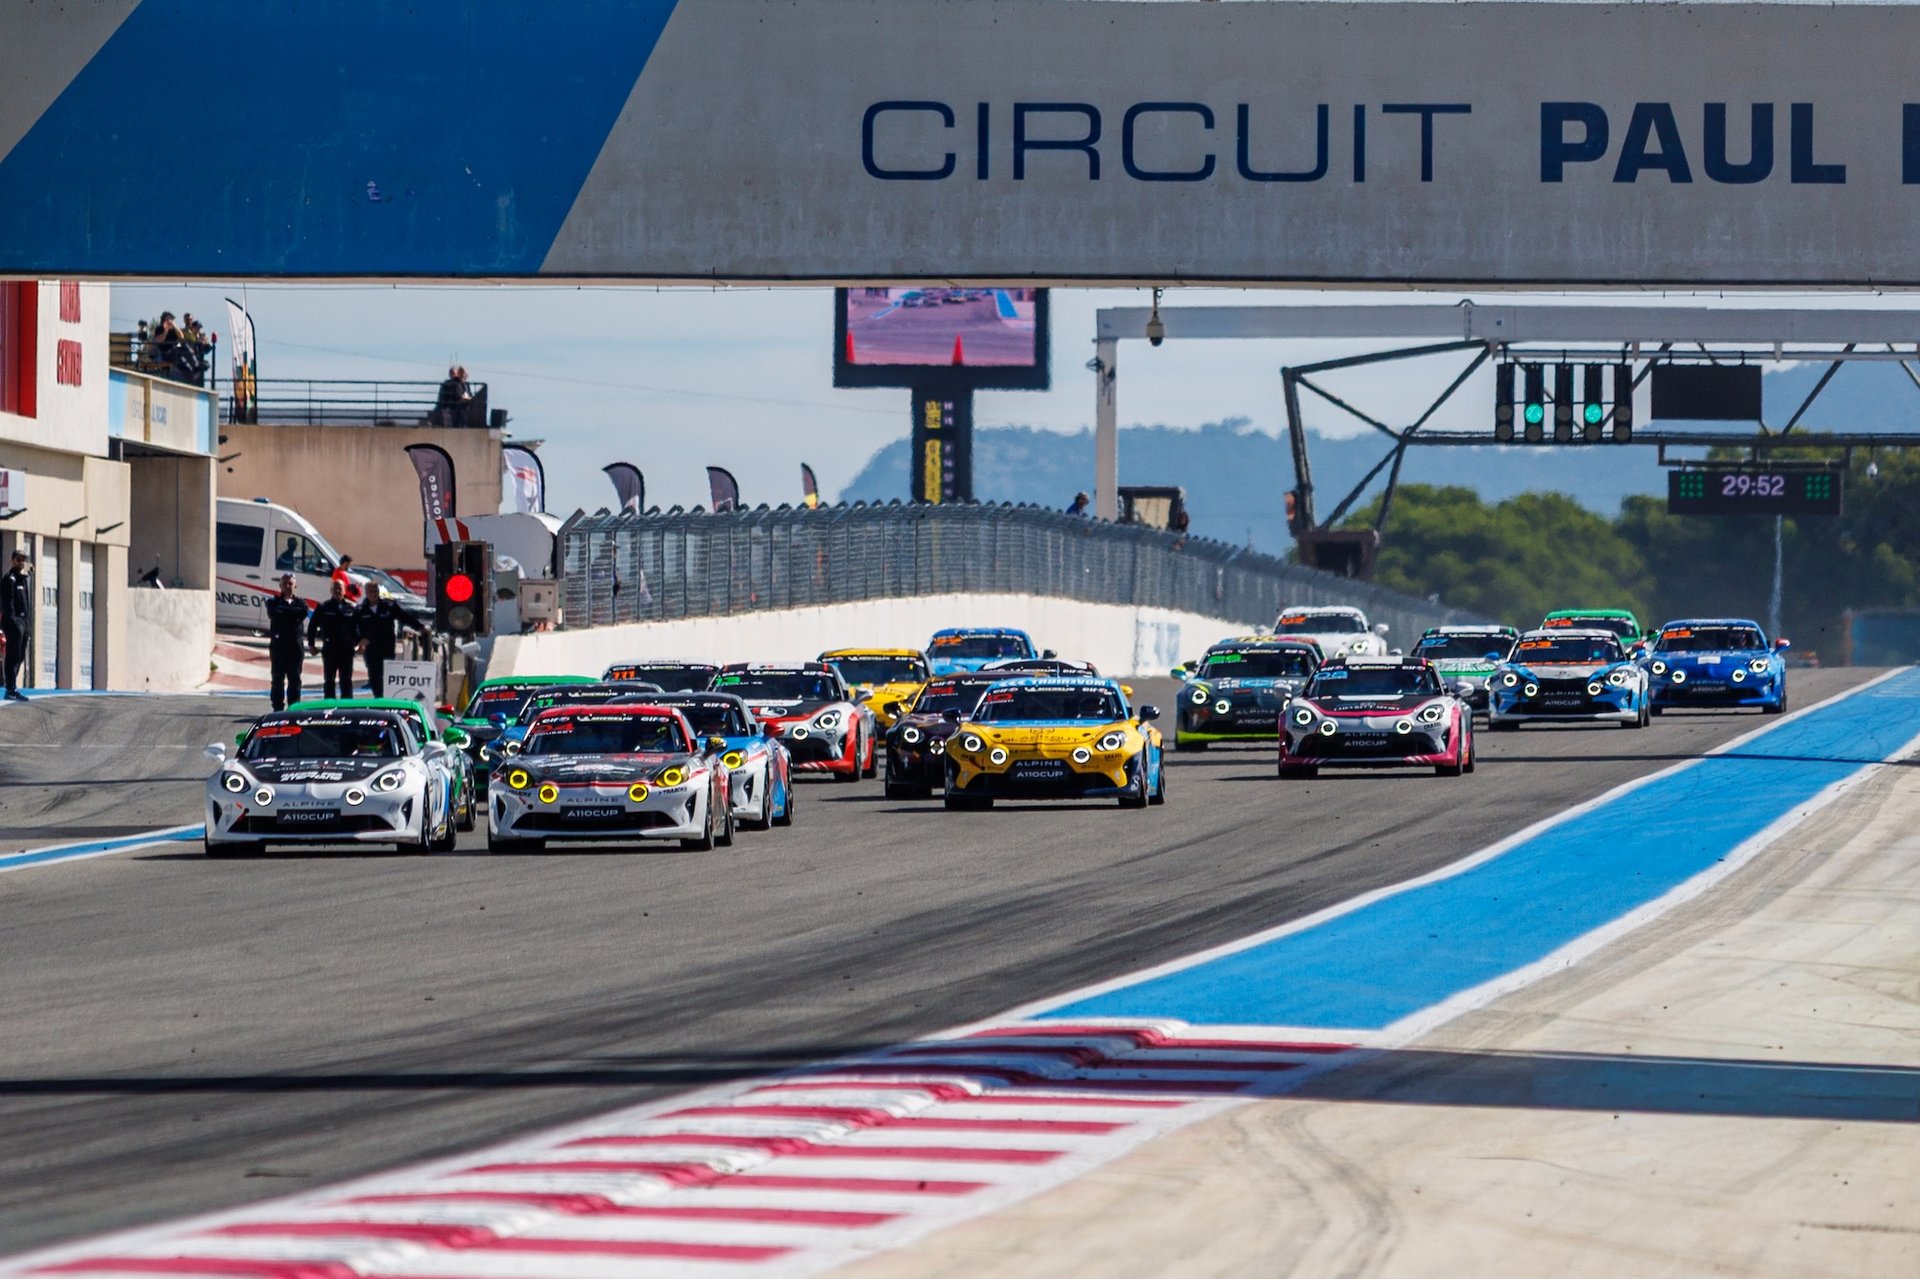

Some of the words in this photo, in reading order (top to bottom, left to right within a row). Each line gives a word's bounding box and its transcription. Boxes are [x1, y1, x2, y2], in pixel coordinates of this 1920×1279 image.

[861, 99, 1472, 182] CIRCUIT
[1539, 102, 1846, 185] PAUL
[1721, 475, 1785, 496] 29:52
[388, 675, 407, 686] PIT
[408, 676, 433, 687] OUT
[283, 813, 335, 821] A110CUP
[566, 809, 619, 818] A110CUP
